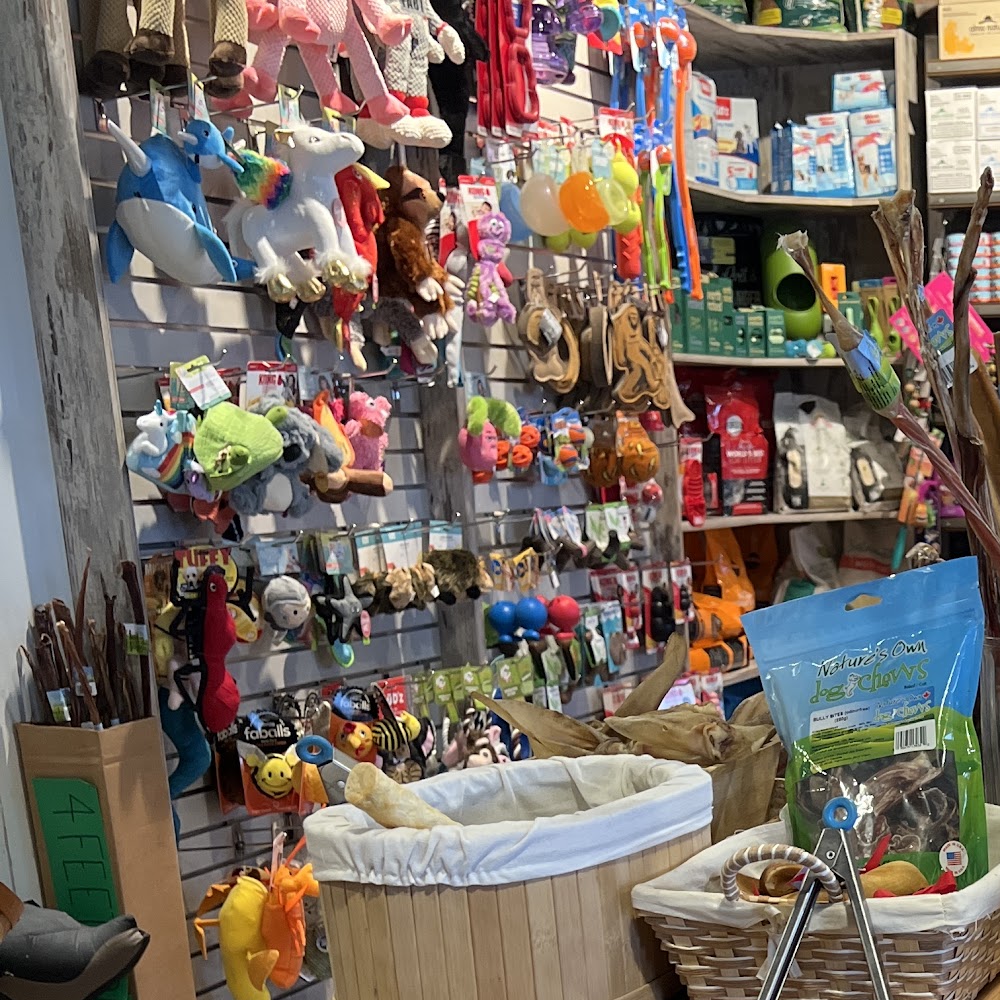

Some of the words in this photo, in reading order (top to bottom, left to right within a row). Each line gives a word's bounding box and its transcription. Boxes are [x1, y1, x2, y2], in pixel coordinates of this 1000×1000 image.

[258, 375, 276, 384] KONG
[174, 550, 231, 567] TUFFY
[818, 647, 888, 678] Nature's
[892, 640, 926, 656] Own
[810, 680, 845, 704] dog
[340, 698, 370, 712] faballs
[244, 726, 291, 740] faballs
[52, 794, 95, 822] 4
